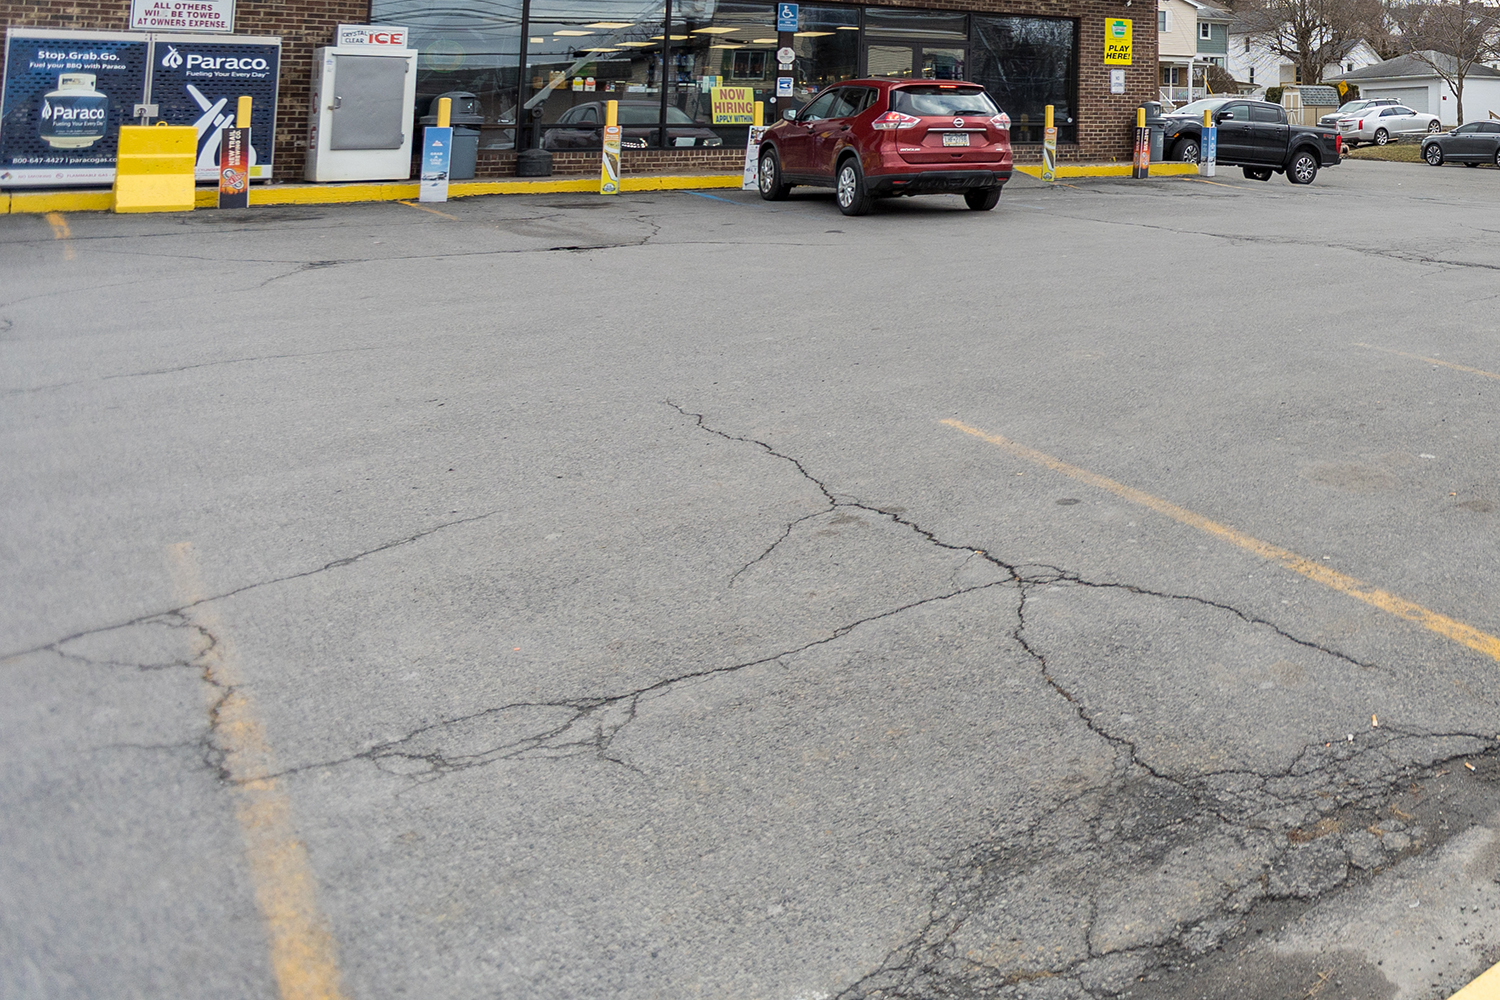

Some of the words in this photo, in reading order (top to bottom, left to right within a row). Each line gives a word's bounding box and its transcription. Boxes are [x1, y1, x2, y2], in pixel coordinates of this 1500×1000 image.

[174, 3, 213, 11] OTHERS
[144, 9, 168, 17] WI
[187, 11, 220, 19] TOWED
[150, 18, 186, 27] OWNERS
[368, 33, 403, 44] ICE
[38, 51, 120, 61] Stop.Grab.Go.
[1106, 52, 1131, 60] HERE!
[719, 89, 745, 100] NOW
[53, 106, 105, 120] Paraco
[714, 102, 753, 114] HIRING
[716, 115, 733, 123] APPLY
